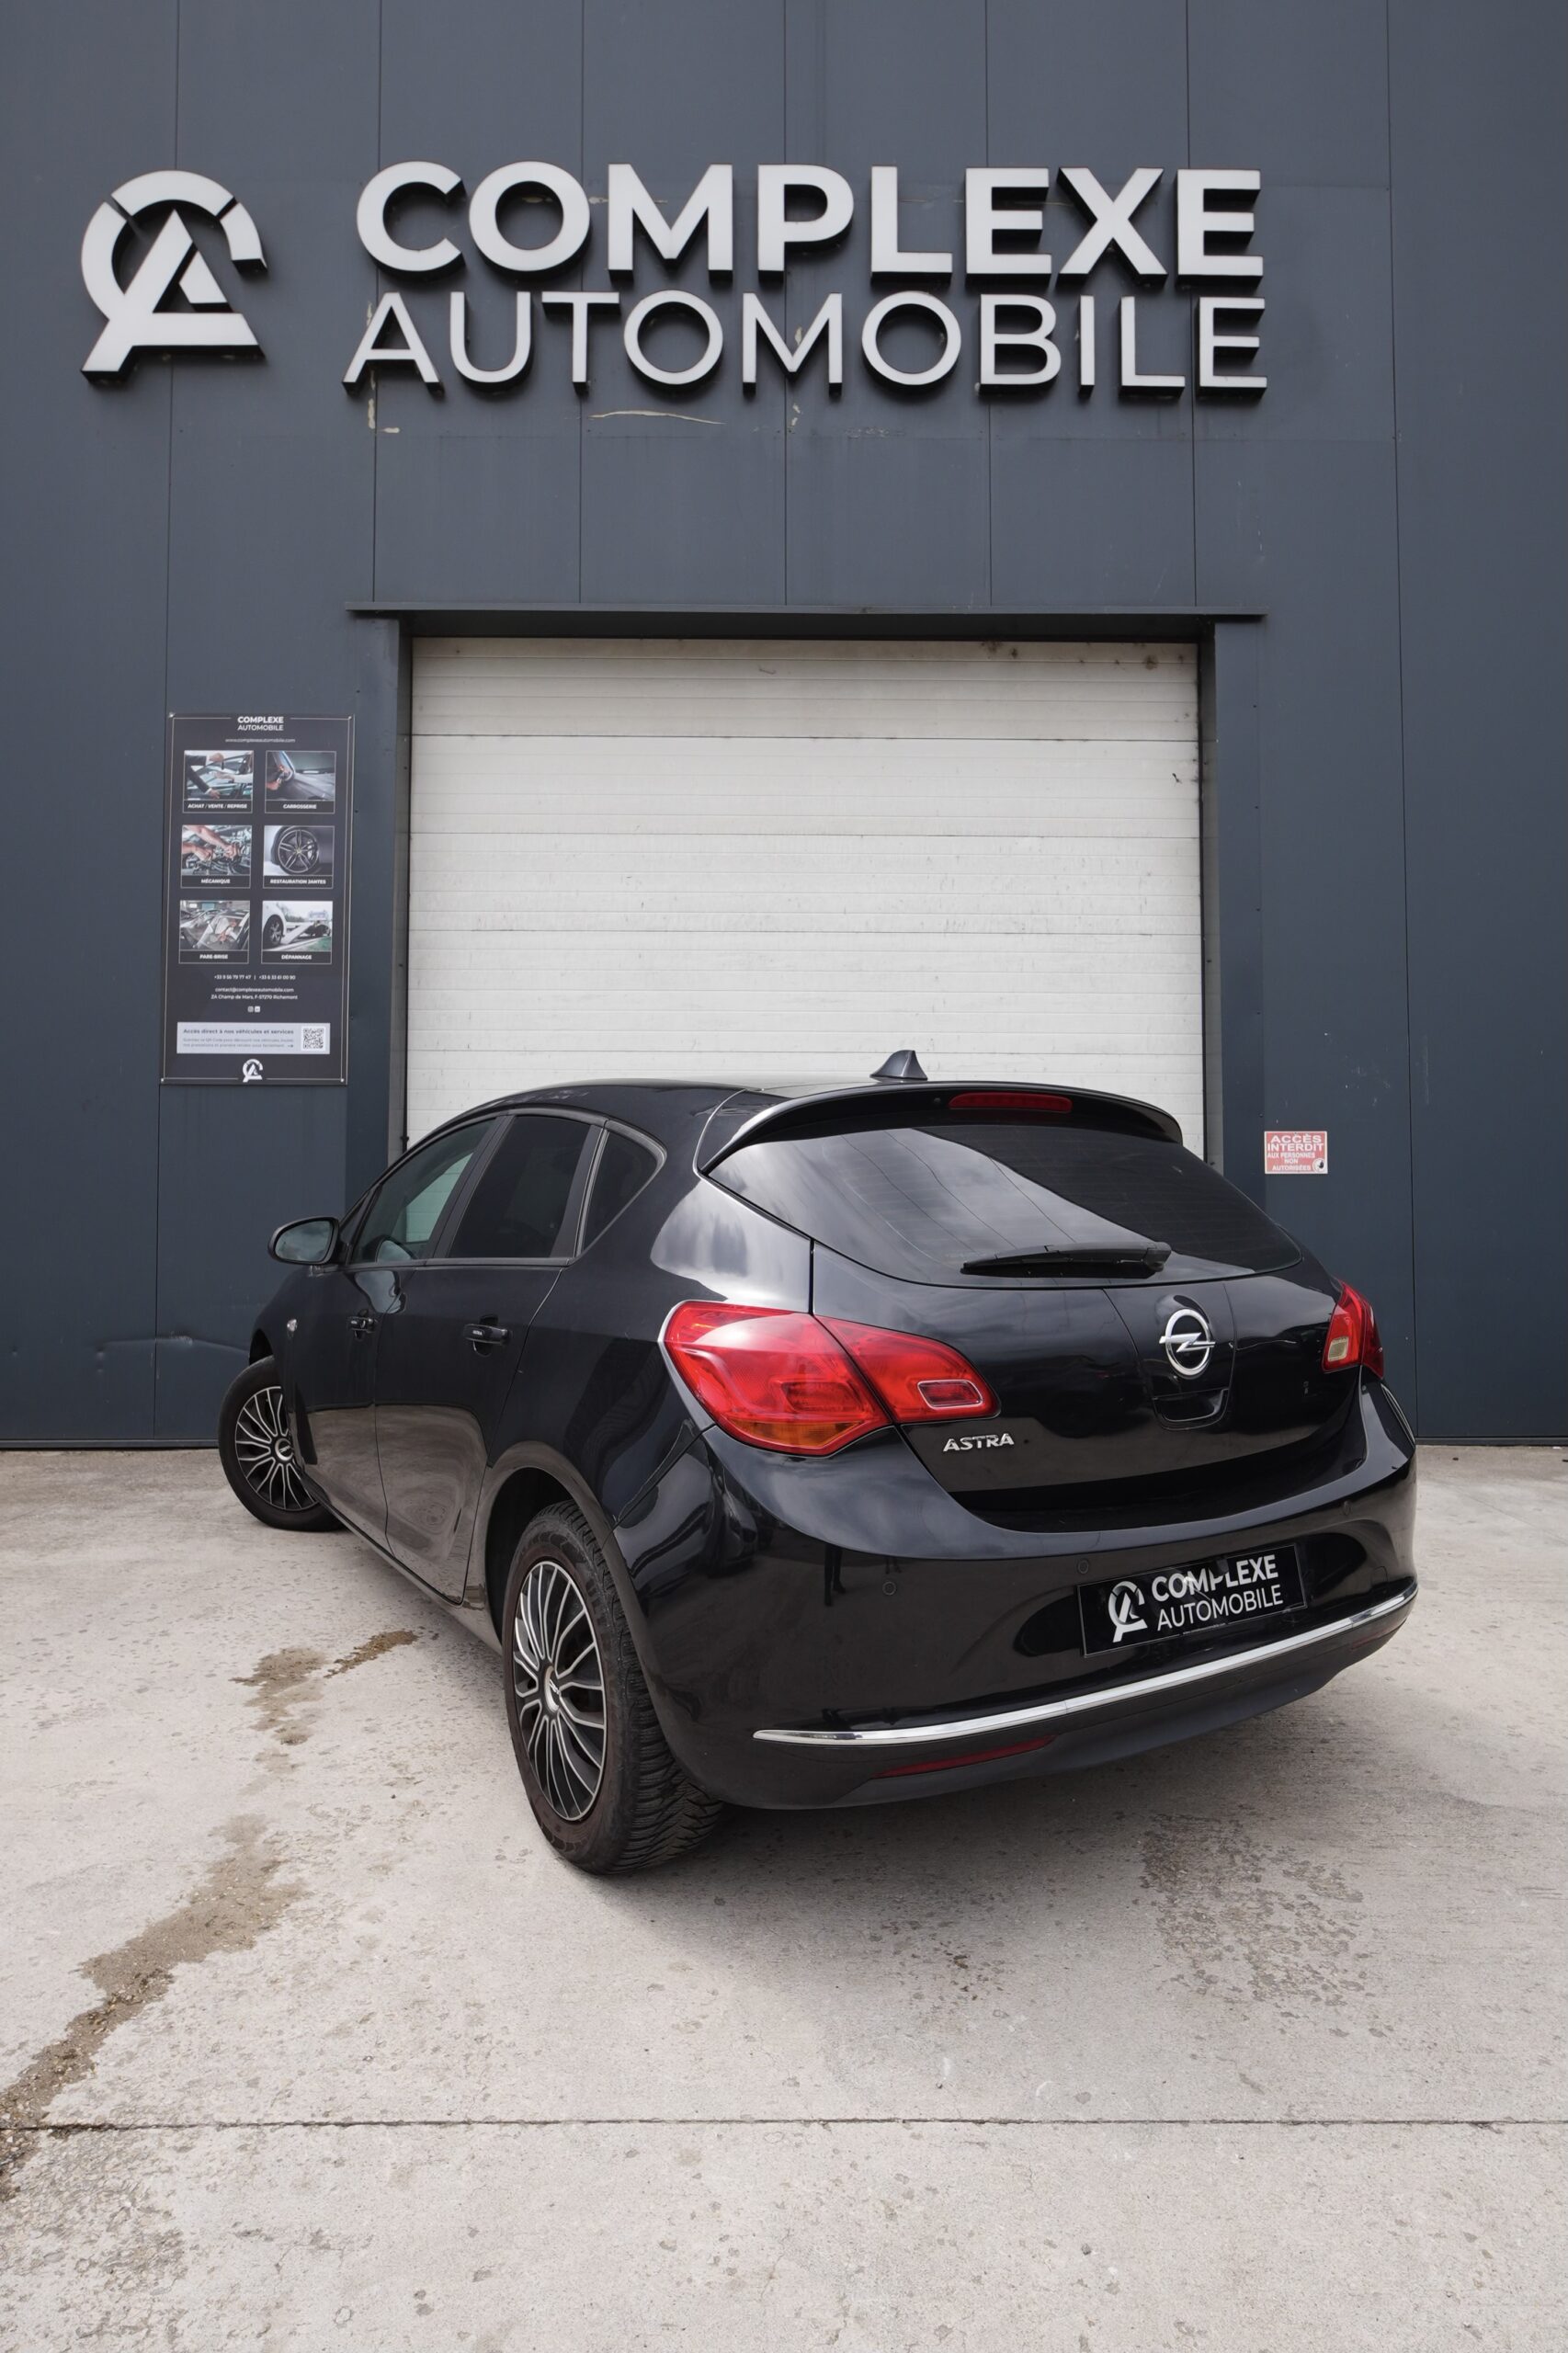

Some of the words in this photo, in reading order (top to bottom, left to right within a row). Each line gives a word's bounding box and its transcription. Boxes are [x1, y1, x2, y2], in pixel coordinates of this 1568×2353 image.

[356, 160, 1265, 282] COMPLEXE
[341, 290, 1268, 392] AUTOMOBILE
[1270, 1133, 1322, 1143] ACCÈS
[942, 1432, 1015, 1452] ASTRA
[1156, 1584, 1284, 1632] AUTOMOBILE
